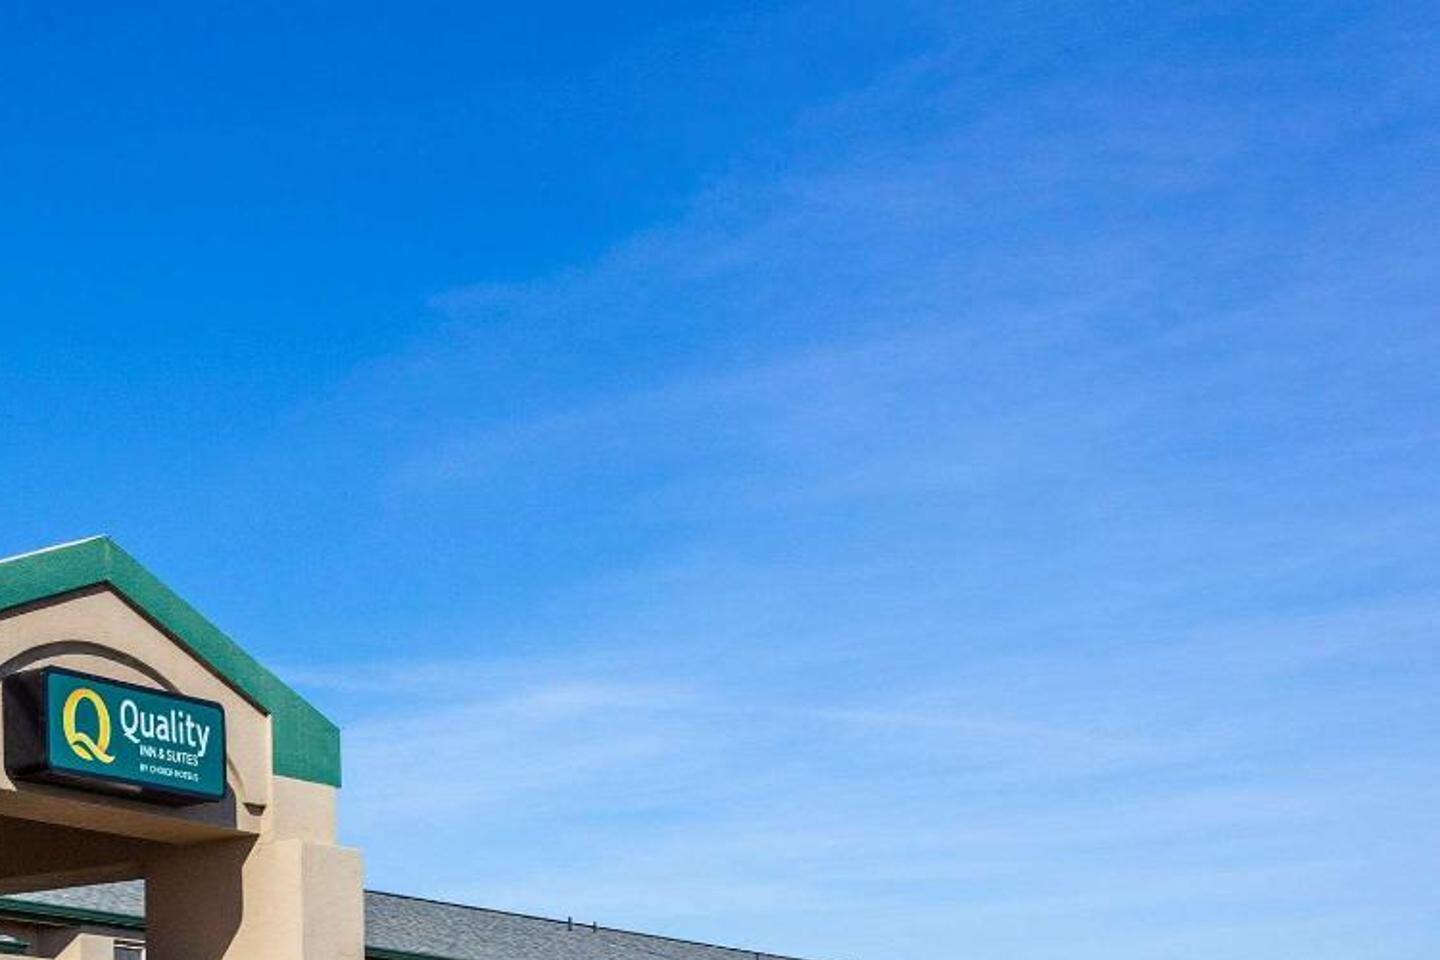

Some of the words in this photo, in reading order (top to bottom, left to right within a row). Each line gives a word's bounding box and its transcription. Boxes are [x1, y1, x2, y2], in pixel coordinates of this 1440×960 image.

[120, 699, 210, 757] Quality
[139, 744, 157, 758] INN
[158, 747, 165, 760] &
[166, 749, 199, 767] SUITES
